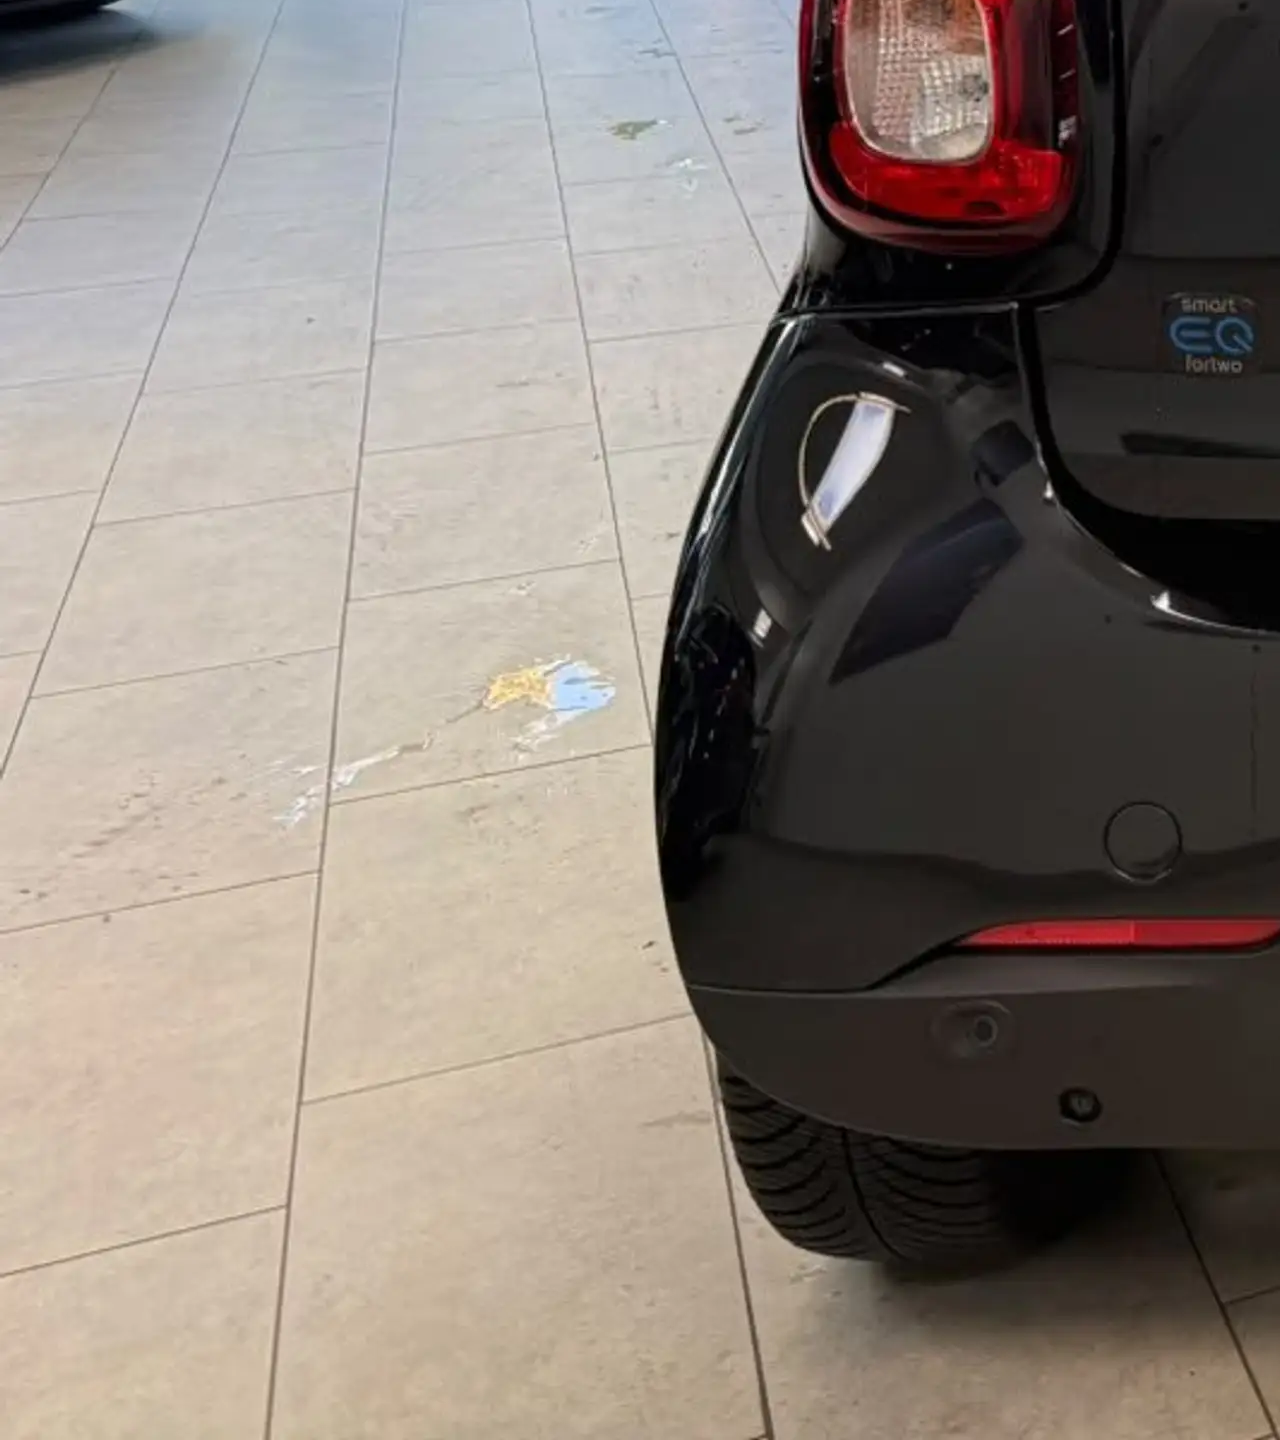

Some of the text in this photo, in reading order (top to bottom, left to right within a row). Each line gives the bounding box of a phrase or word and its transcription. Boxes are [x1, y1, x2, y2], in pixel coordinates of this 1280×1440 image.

[1181, 298, 1239, 314] smart
[1170, 316, 1255, 356] EQ
[1185, 354, 1244, 373] fortwo
